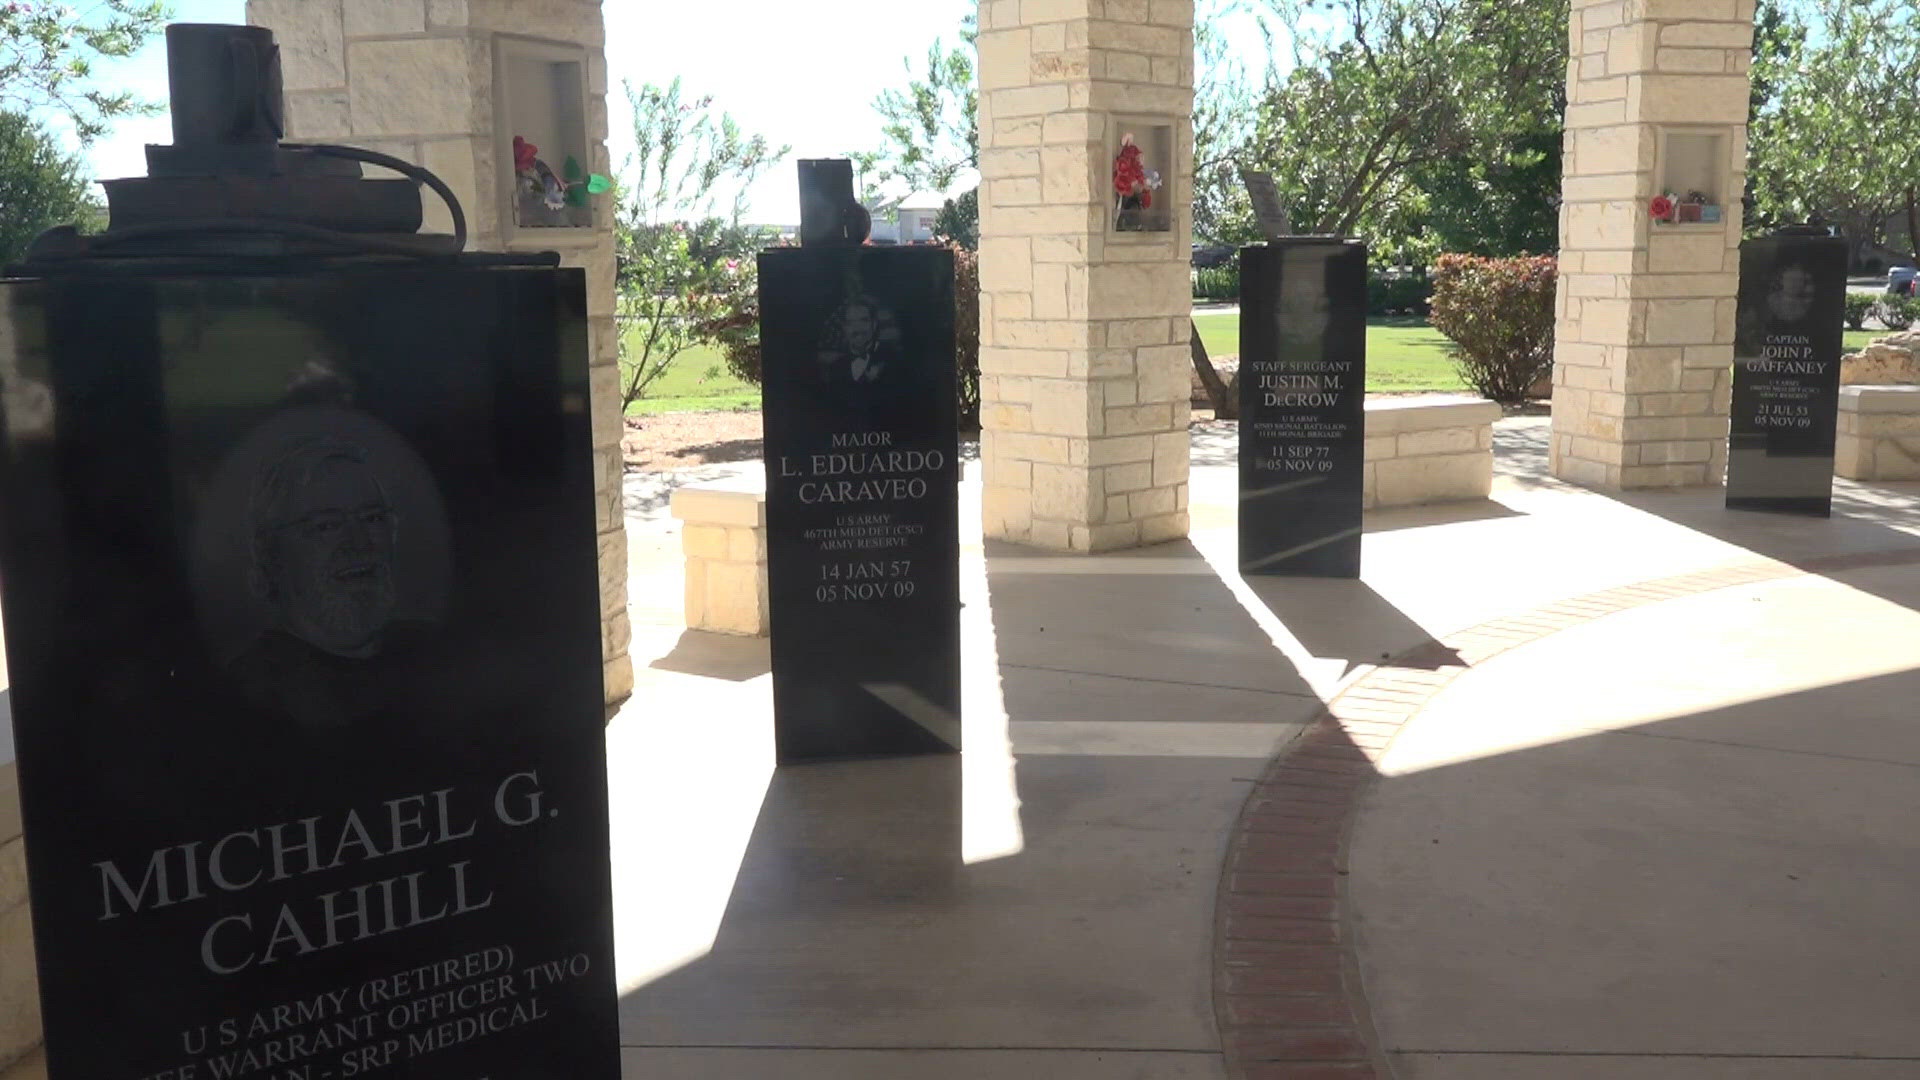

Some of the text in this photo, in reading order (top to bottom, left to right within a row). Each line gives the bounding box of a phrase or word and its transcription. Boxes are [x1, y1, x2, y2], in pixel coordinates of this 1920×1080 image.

[1766, 335, 1809, 344] CAPTAIN
[1760, 345, 1813, 359] JOHN P.
[1252, 360, 1352, 372] STAFF SERGEANT
[1746, 361, 1827, 374] GAFFANEY
[1259, 374, 1344, 389] JUSTIN M.
[1758, 404, 1770, 414] 21
[1773, 405, 1793, 415] JUL
[1304, 423, 1347, 431] BATTALION
[1754, 415, 1811, 427] 05 NOV 09
[832, 431, 892, 448] MAJOR
[1307, 430, 1341, 438] BRIGADE
[1273, 446, 1330, 458] 11 SEP 77
[781, 449, 944, 477] L. EDUARDO
[1267, 460, 1333, 472] 05 NOV 09
[799, 477, 927, 504] CARAVEO
[836, 514, 891, 527] U S ARMY
[803, 524, 924, 540] 467TH MED DET (CSC)
[820, 536, 909, 551] ARMY RESERVE
[821, 560, 911, 580] 14 JAN 57
[816, 581, 915, 602] 05 NOV 09
[94, 769, 559, 920] MICHAEL G.
[200, 860, 494, 975] CAHILL
[182, 944, 514, 1054] U S ARMY (RETIRED)
[207, 953, 590, 1080] WARRANT OFFICER TWO
[341, 1039, 400, 1078] SRP
[408, 998, 549, 1058] MEDICAL
